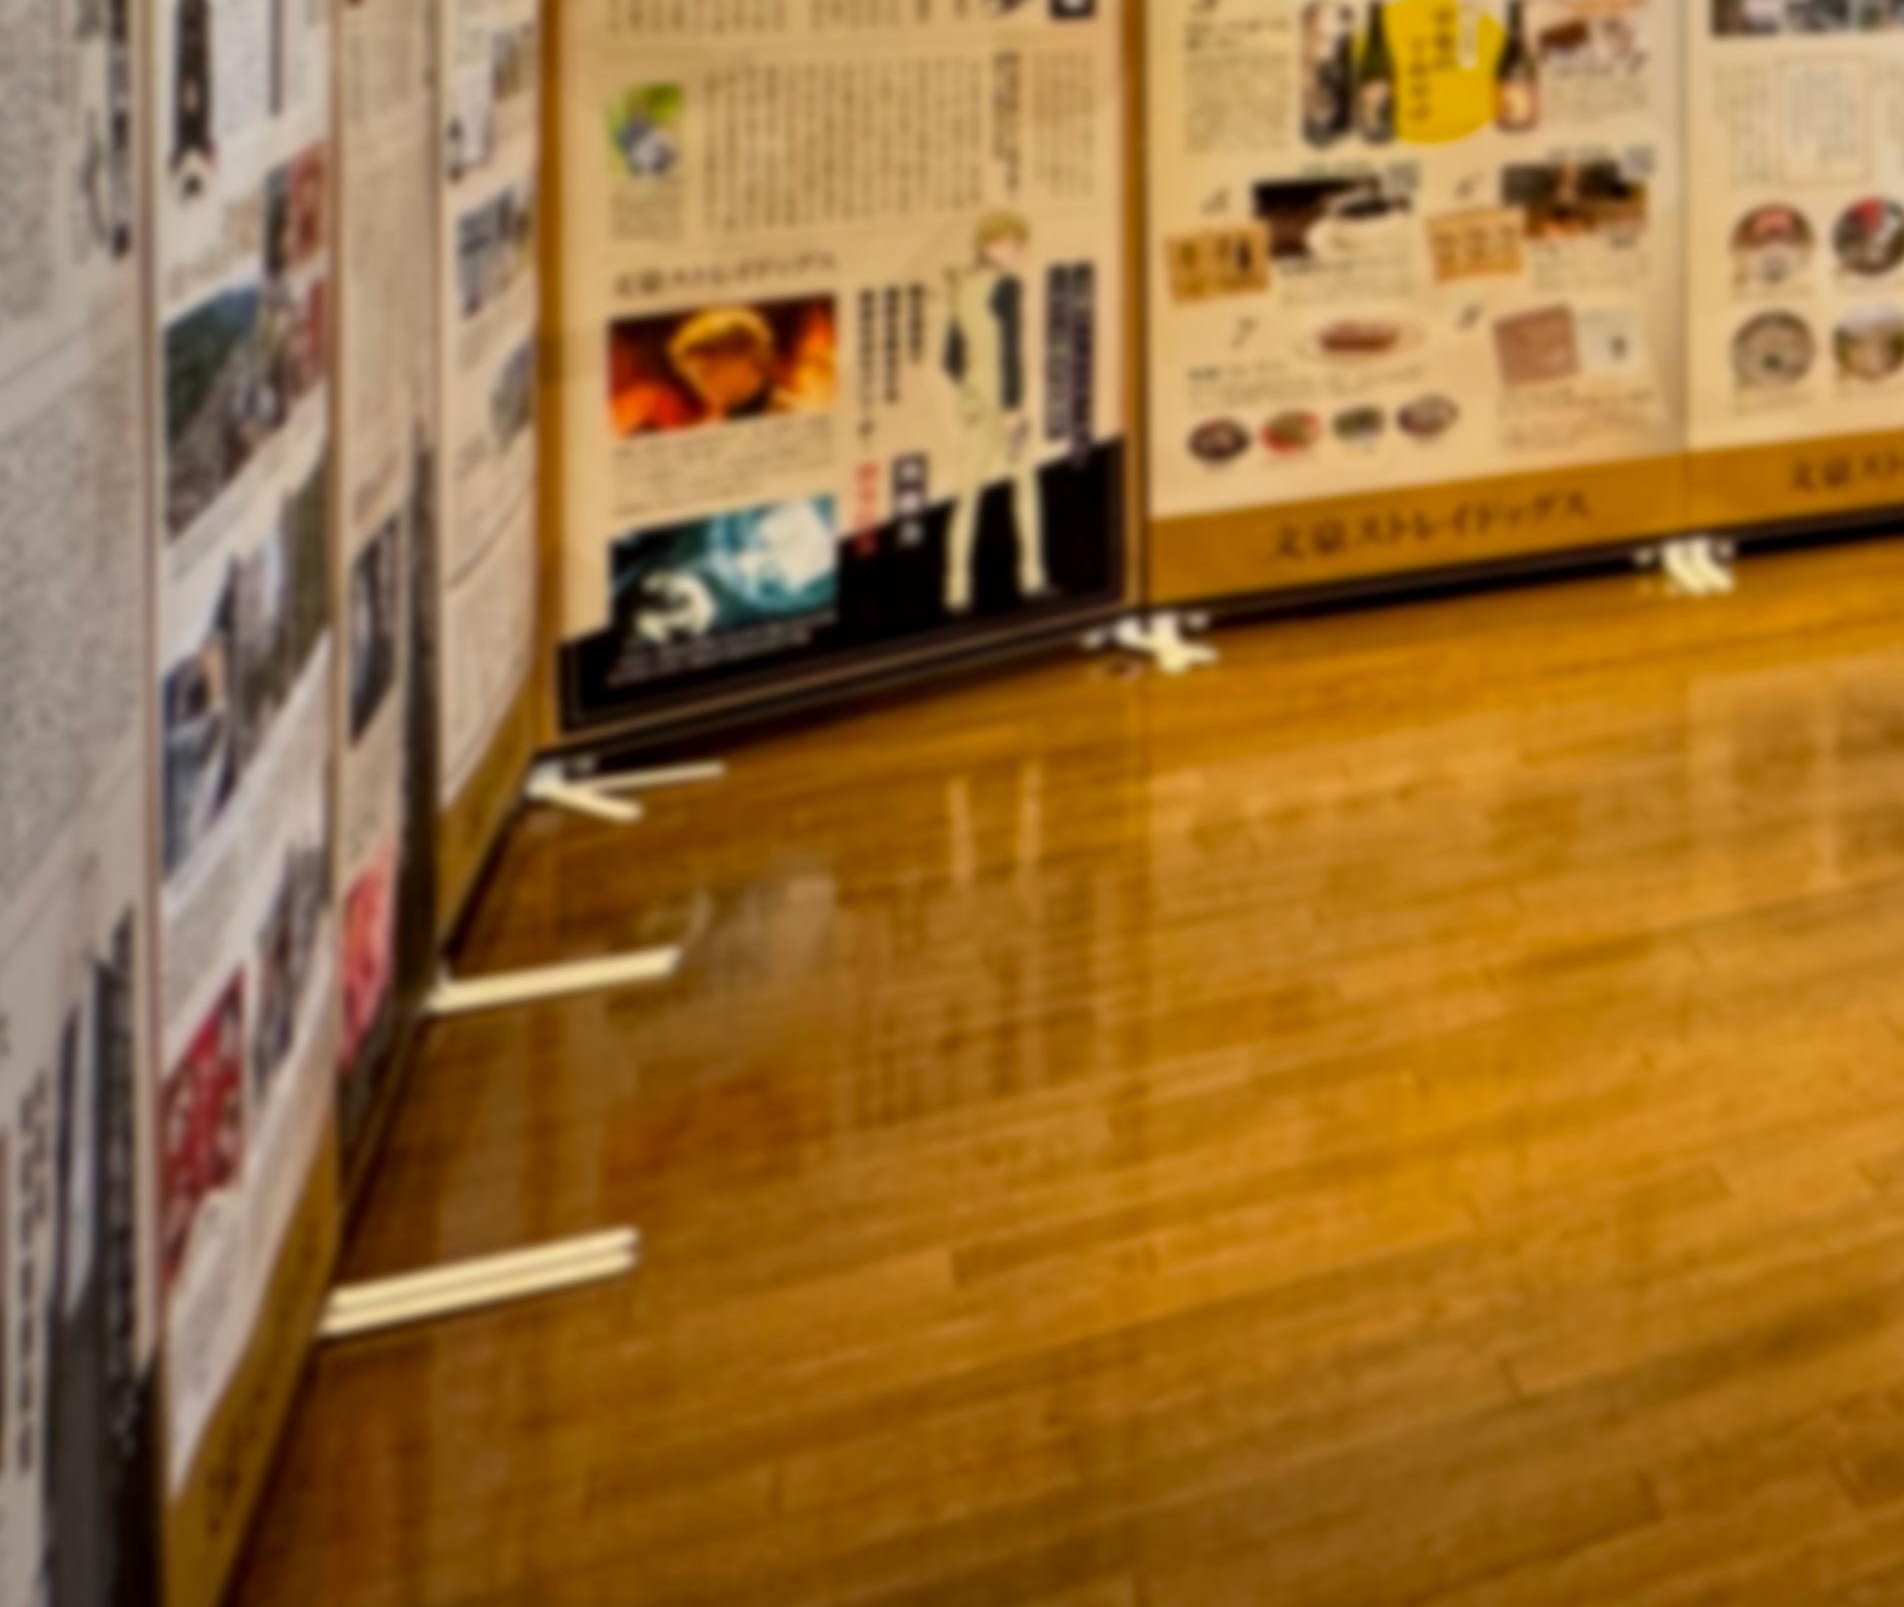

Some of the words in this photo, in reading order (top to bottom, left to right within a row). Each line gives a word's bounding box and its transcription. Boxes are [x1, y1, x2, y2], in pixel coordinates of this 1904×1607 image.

[1272, 489, 1592, 563] 文豪ストレイドッグス
